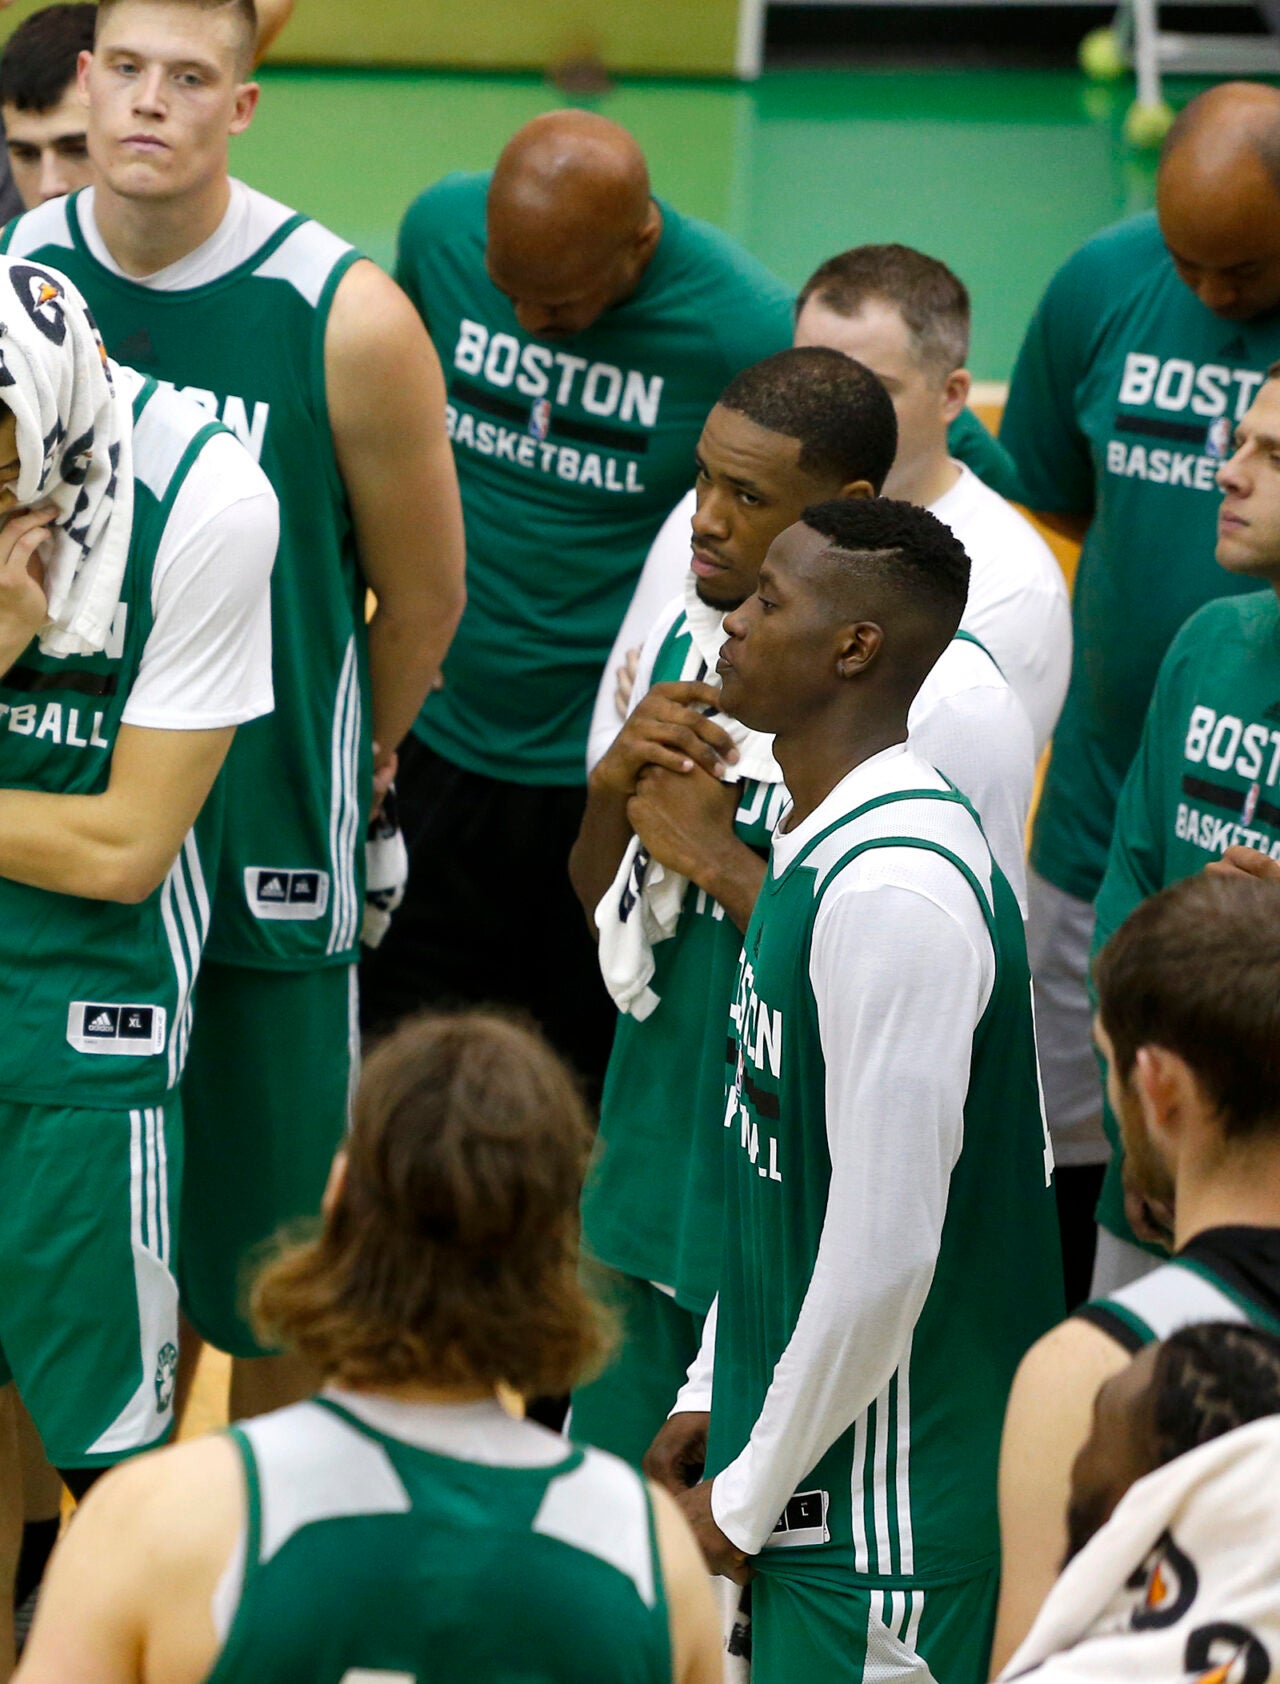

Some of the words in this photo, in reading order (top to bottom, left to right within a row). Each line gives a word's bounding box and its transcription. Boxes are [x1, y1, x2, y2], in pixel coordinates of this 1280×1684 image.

[454, 317, 664, 427] BOSTON
[446, 403, 645, 493] BASKETBALL
[87, 1024, 115, 1033] adidas
[128, 1018, 142, 1028] XL
[801, 1506, 809, 1517] L
